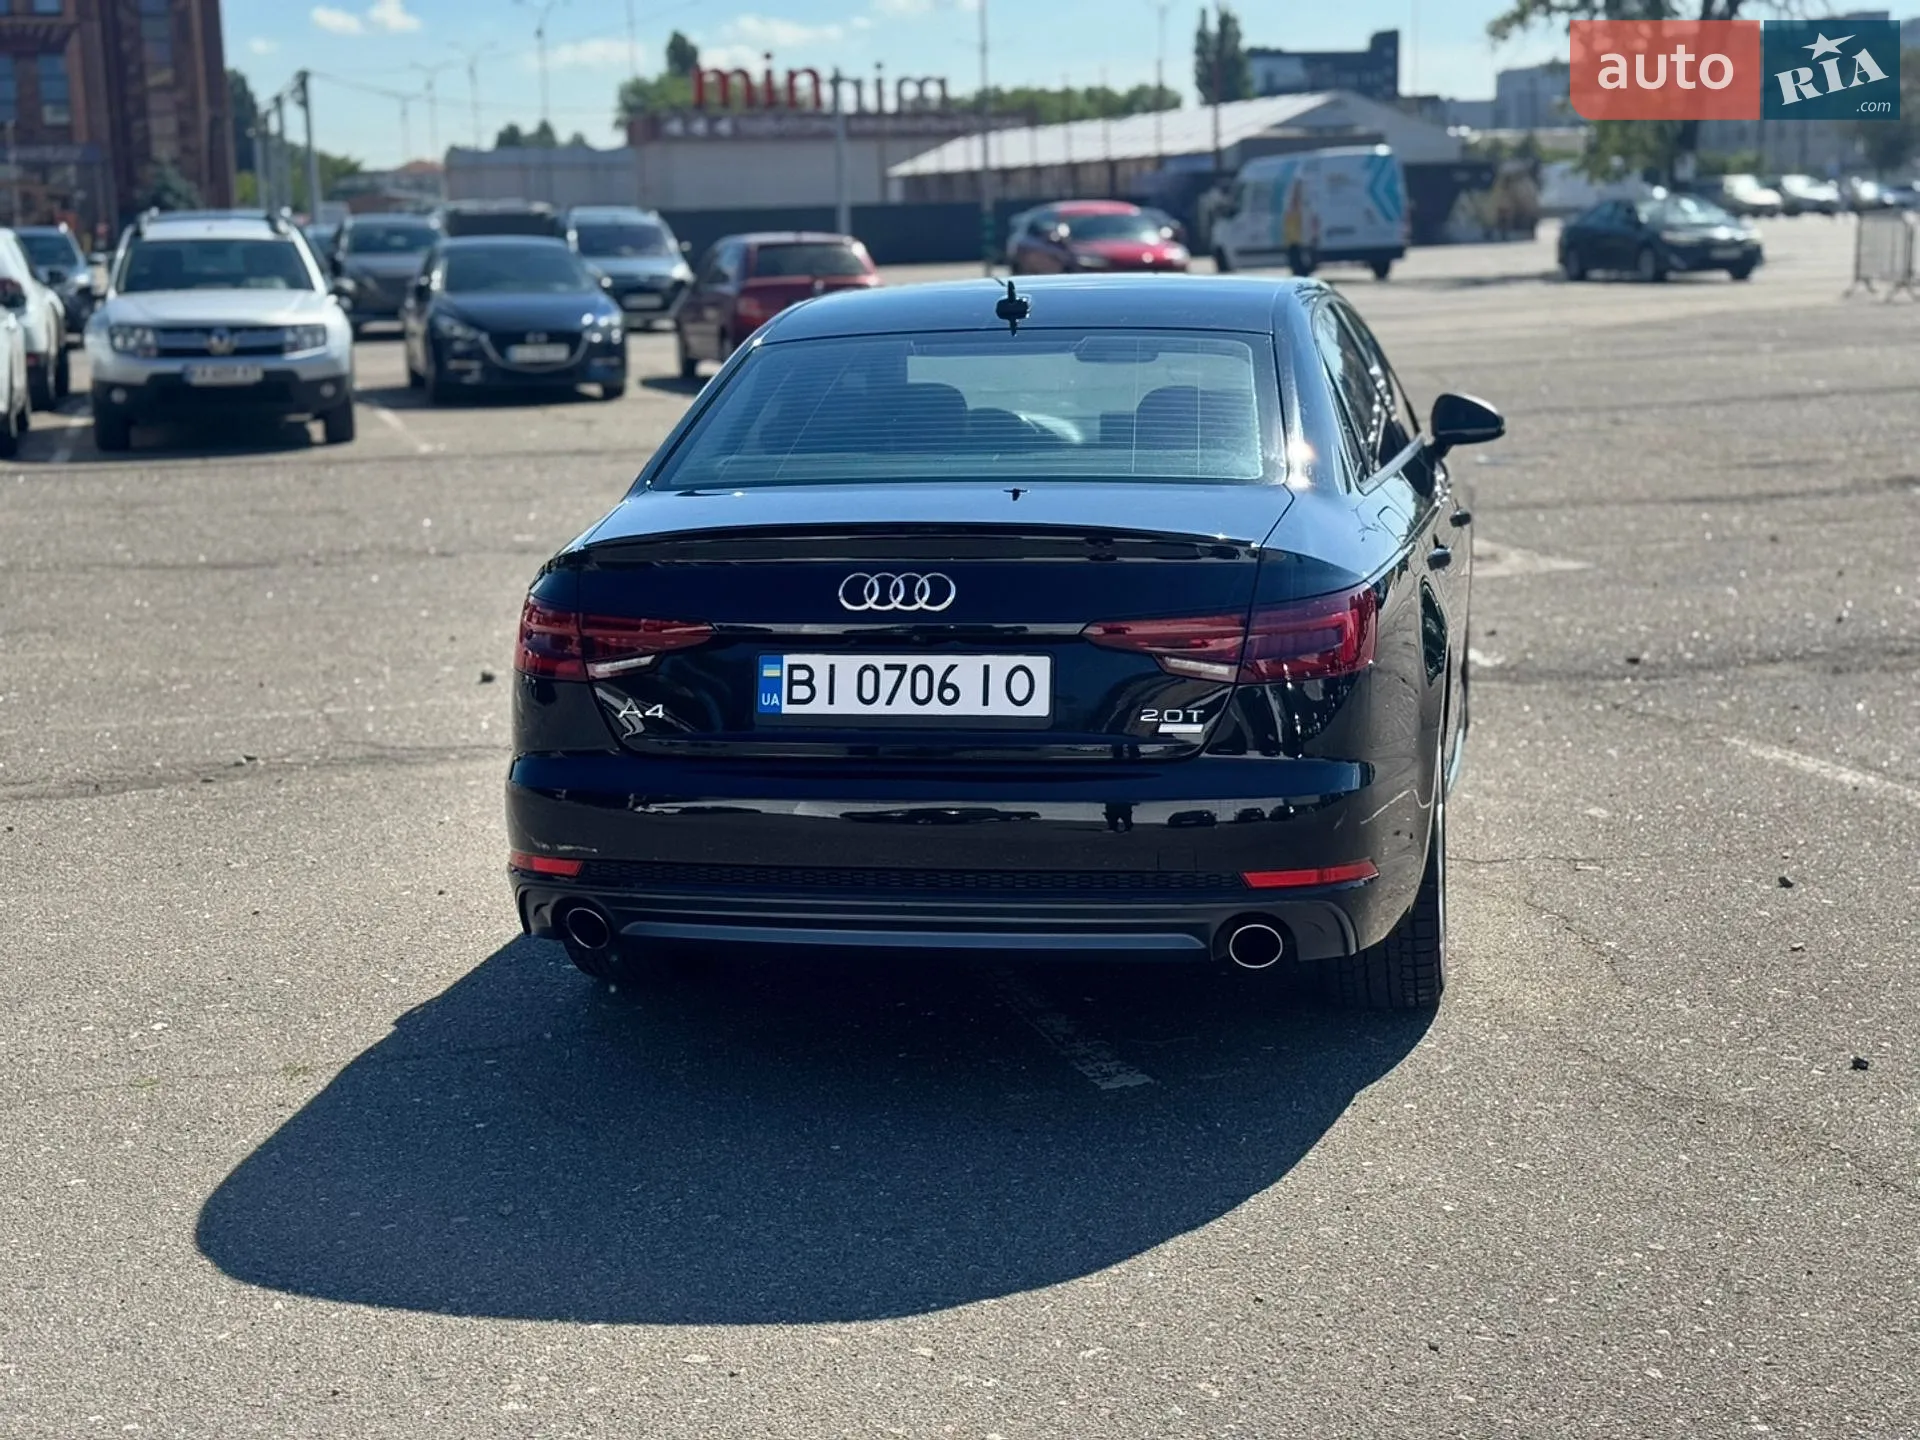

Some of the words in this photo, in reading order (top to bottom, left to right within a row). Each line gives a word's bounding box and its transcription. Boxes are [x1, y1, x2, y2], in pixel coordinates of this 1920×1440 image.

[786, 664, 836, 706] BI
[857, 664, 961, 707] 0706
[981, 664, 1036, 707] IO
[761, 692, 780, 706] UA
[619, 698, 665, 718] A4
[1140, 709, 1205, 723] 2.0T
